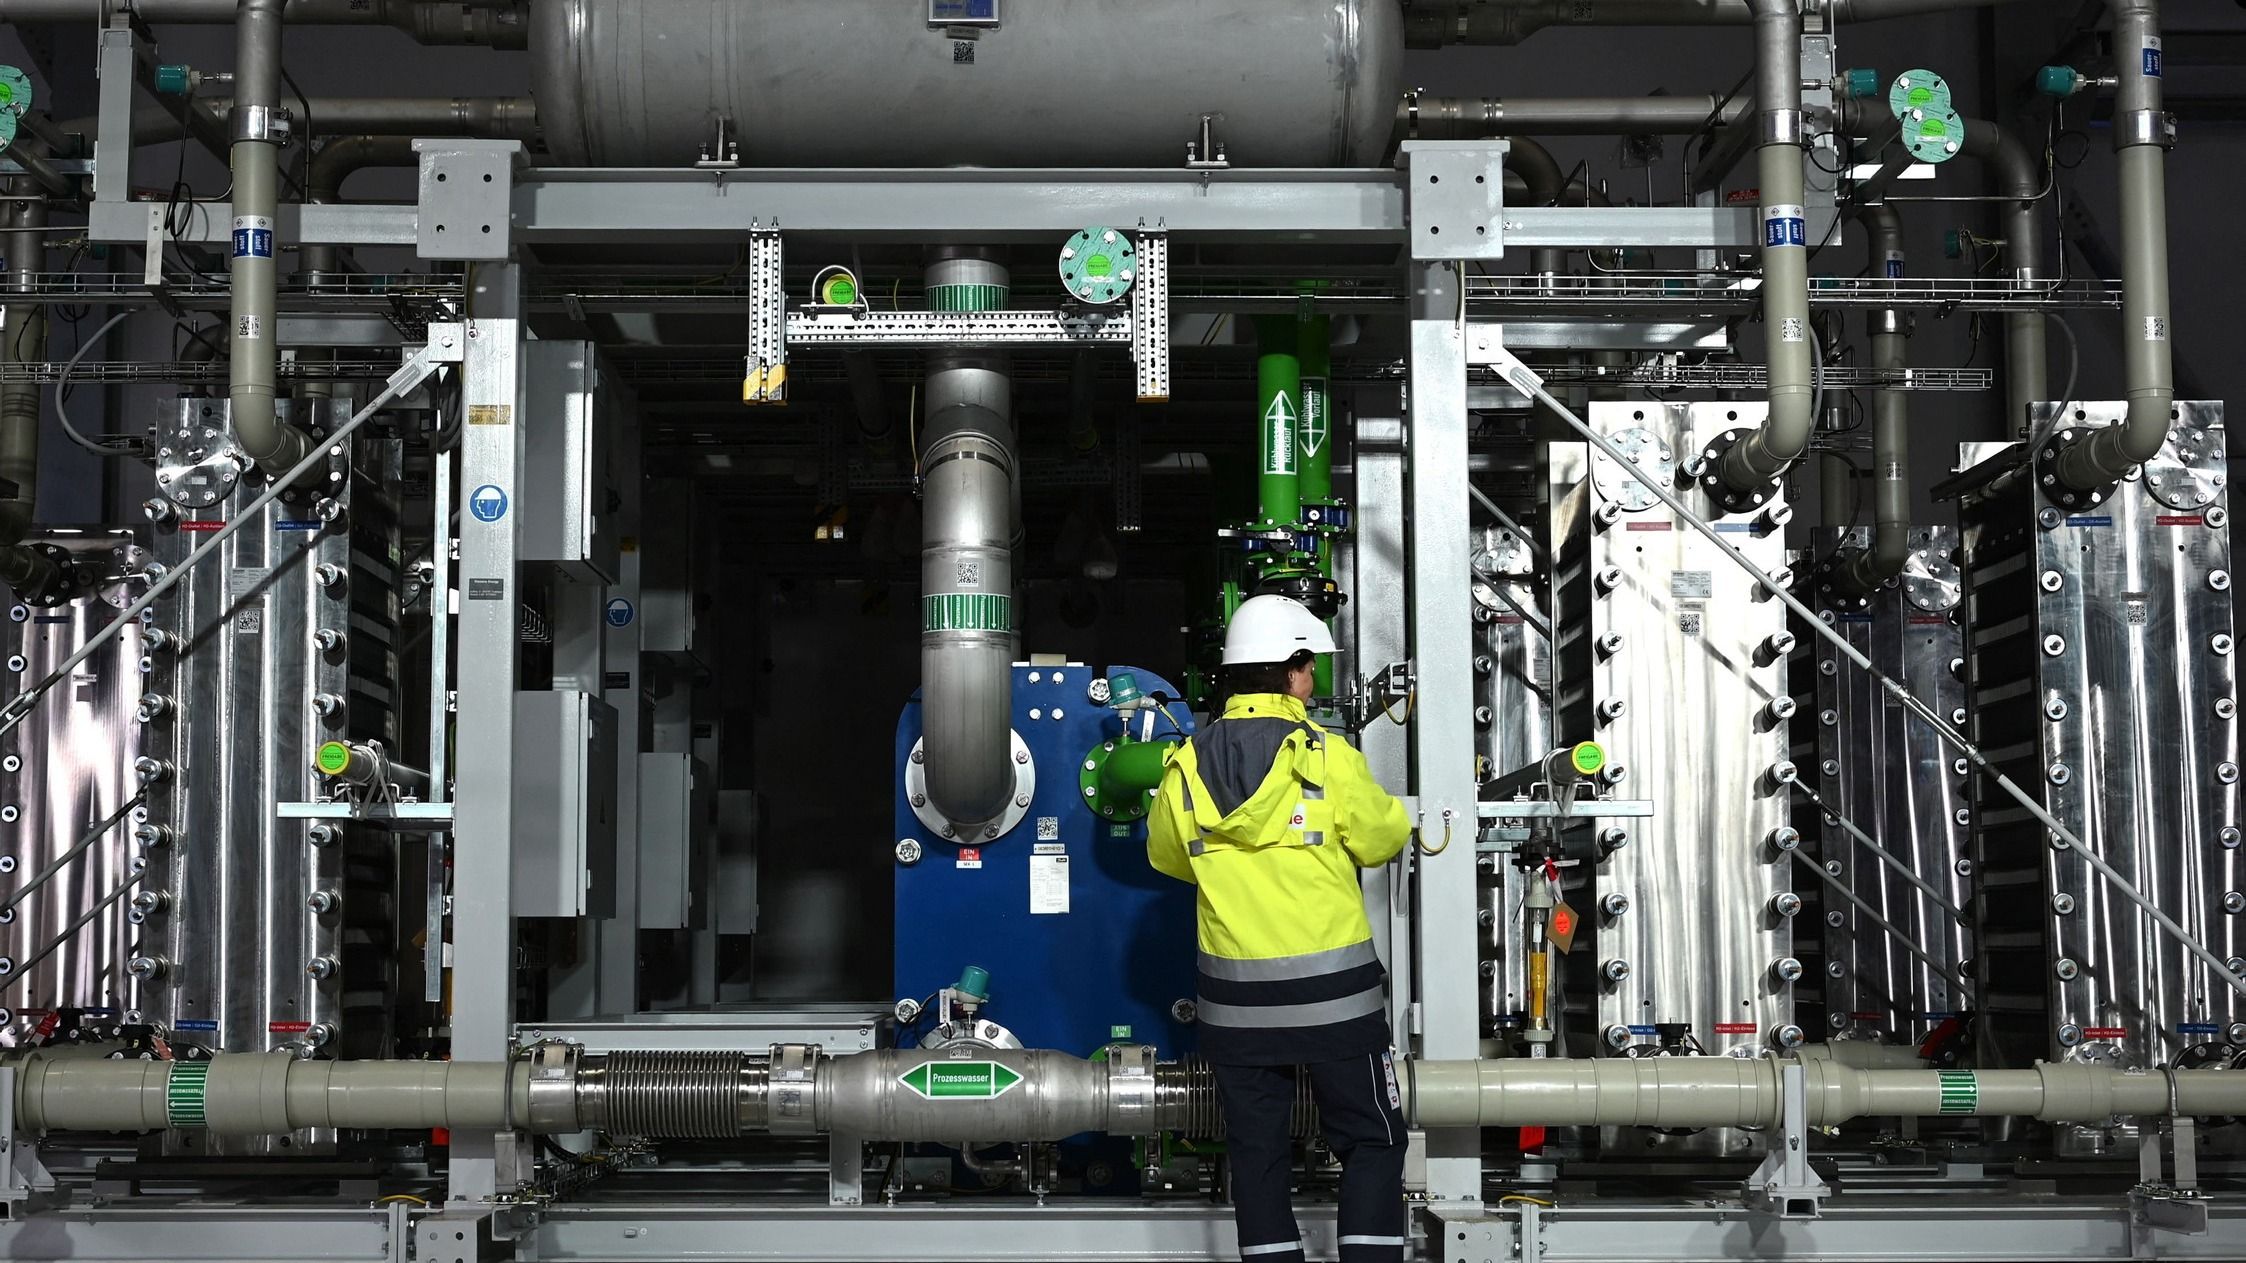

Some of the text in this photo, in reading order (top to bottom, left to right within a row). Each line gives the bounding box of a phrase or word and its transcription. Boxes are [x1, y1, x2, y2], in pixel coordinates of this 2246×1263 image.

[1300, 382, 1310, 428] Kühlwasser
[1311, 390, 1320, 418] Vorlauf
[932, 1074, 989, 1083] Prozesswasser
